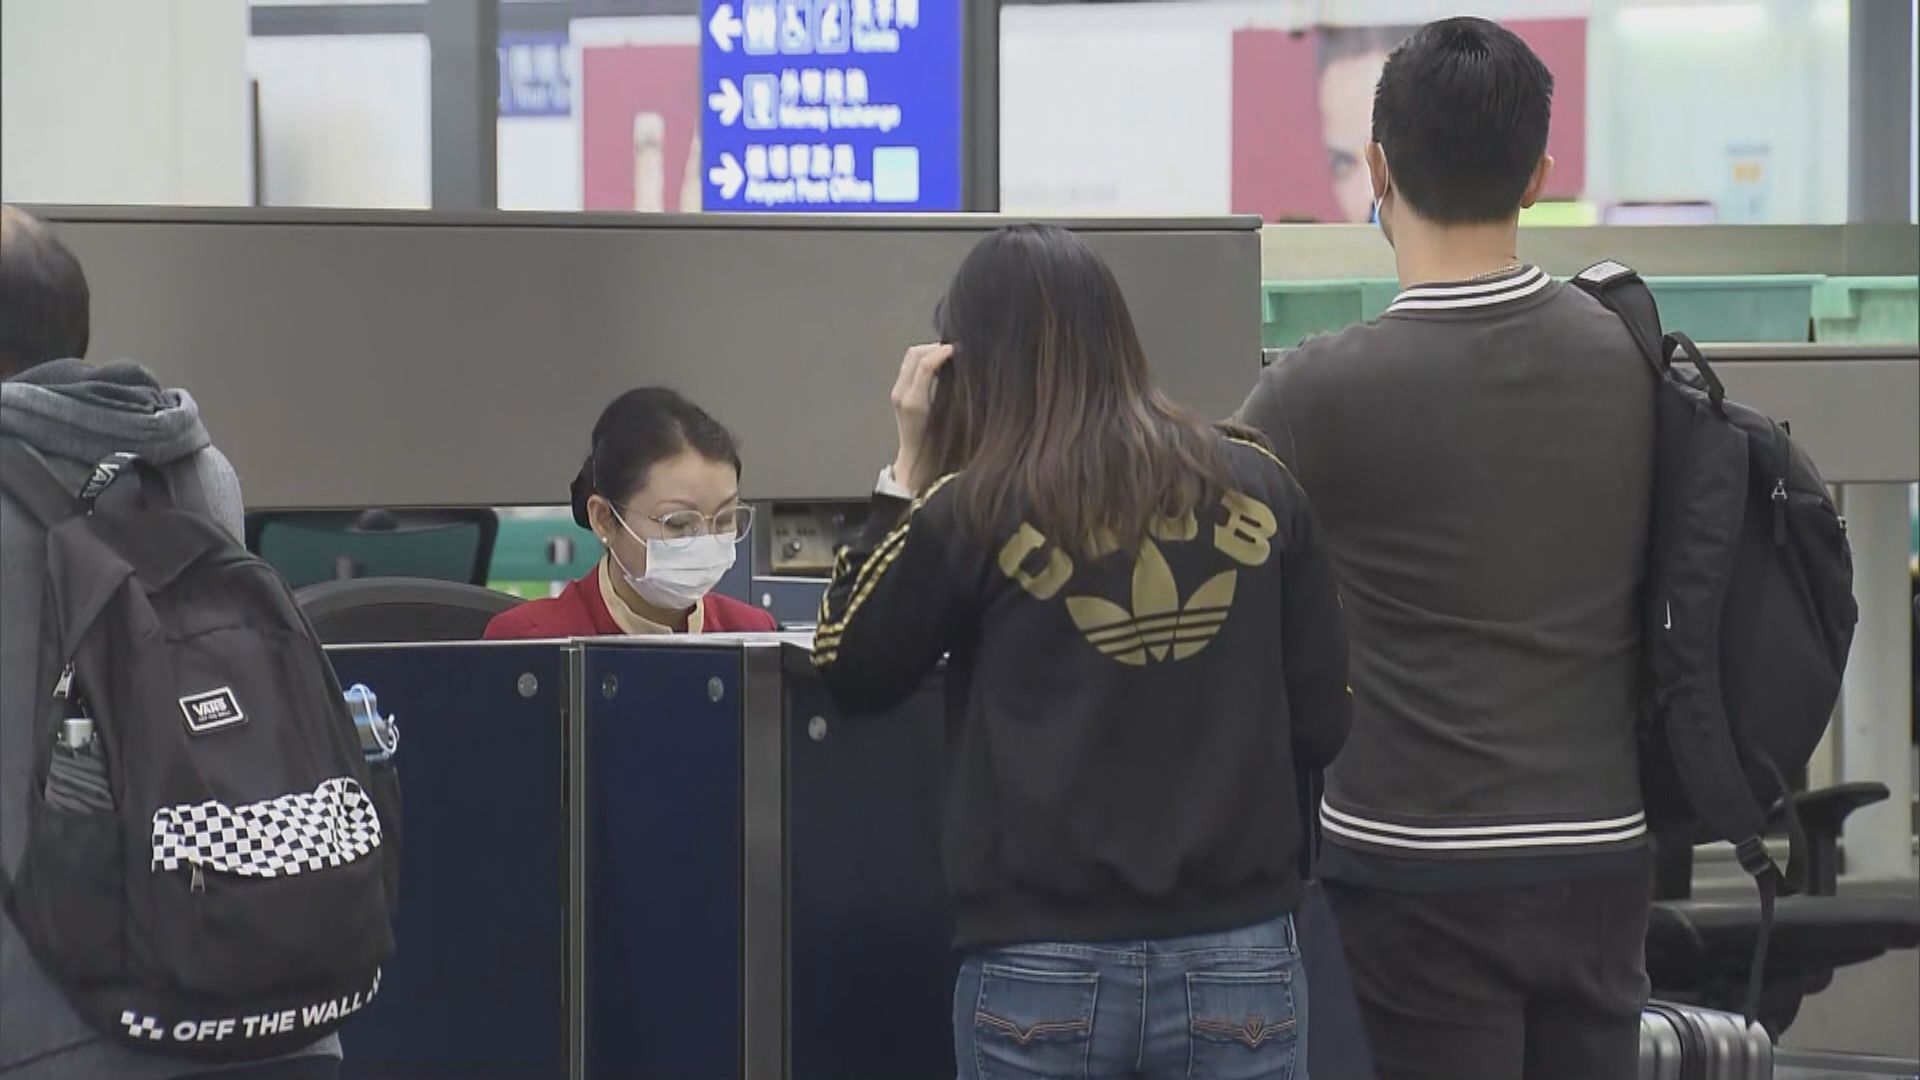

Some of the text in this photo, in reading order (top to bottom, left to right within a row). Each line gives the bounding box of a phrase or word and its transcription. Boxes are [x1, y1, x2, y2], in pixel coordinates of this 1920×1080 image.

[829, 104, 902, 132] Exchange
[745, 178, 874, 206] Airport Post Office
[191, 697, 227, 716] VANS
[172, 991, 362, 1042] OFF THE WALL
